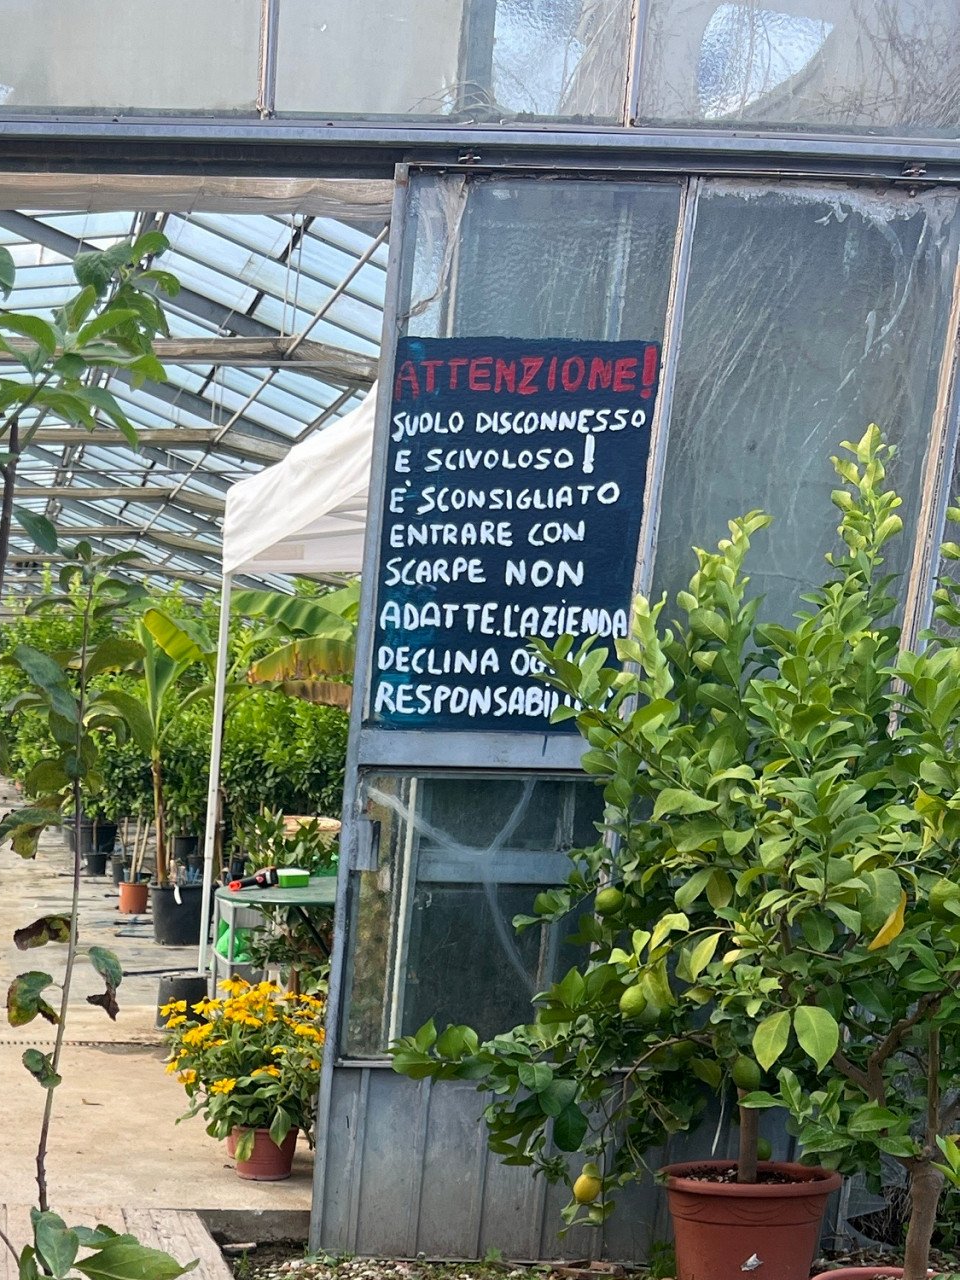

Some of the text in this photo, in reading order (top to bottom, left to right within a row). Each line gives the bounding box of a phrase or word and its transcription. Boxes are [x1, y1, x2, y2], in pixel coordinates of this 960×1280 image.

[394, 345, 657, 401] ATTENZIONE!
[392, 409, 646, 442] SUOLO DISCONNESSO
[395, 450, 411, 473] E
[416, 481, 620, 515] SCONSIGLIATO
[390, 520, 585, 548] ENTRARE CON
[384, 557, 584, 588] SCARPE NON
[378, 646, 587, 676] DECLINA OG
